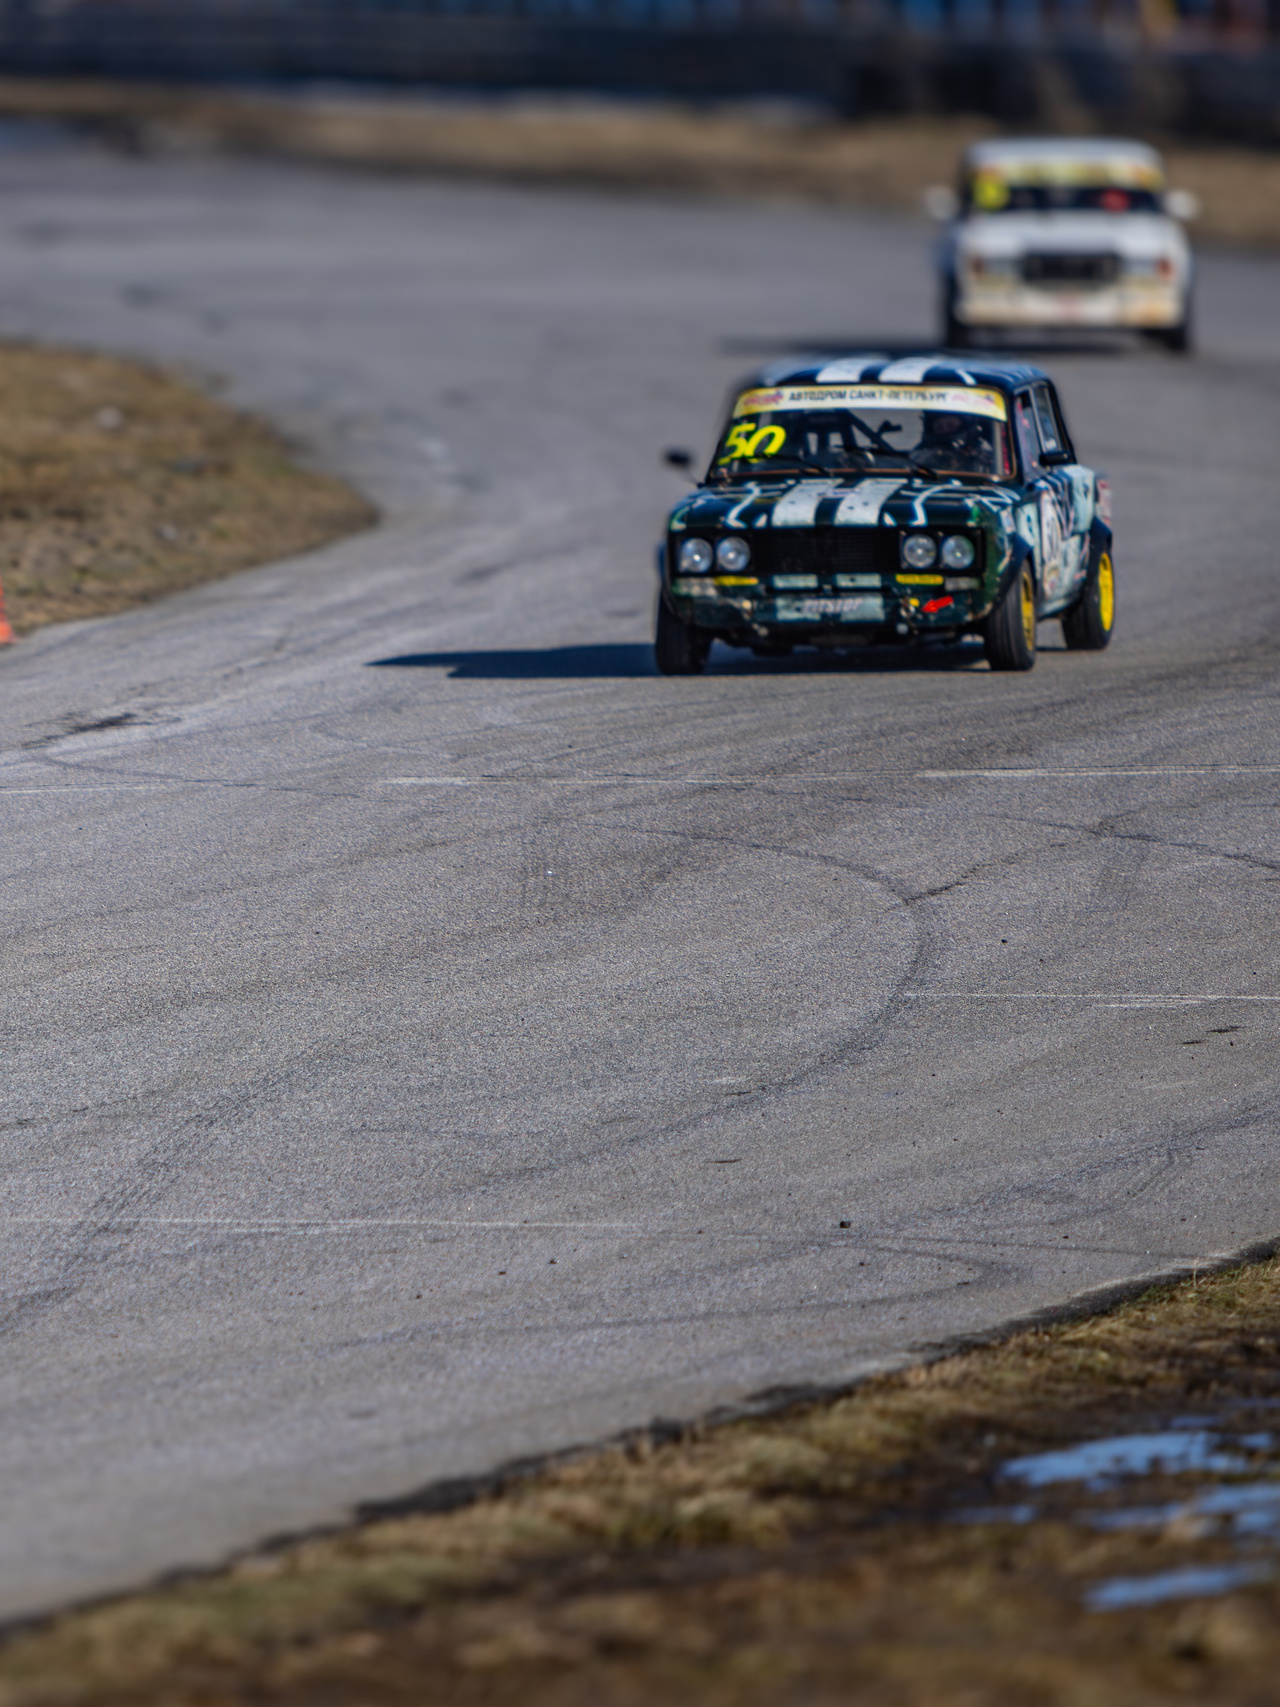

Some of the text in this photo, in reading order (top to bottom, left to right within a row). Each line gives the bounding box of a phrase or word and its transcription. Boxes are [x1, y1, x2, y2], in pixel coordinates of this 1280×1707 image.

[788, 389, 848, 402] АВТОДРОМ
[849, 388, 948, 402] САНКТ-ПЕТЕРБУРГ
[718, 422, 787, 465] 50
